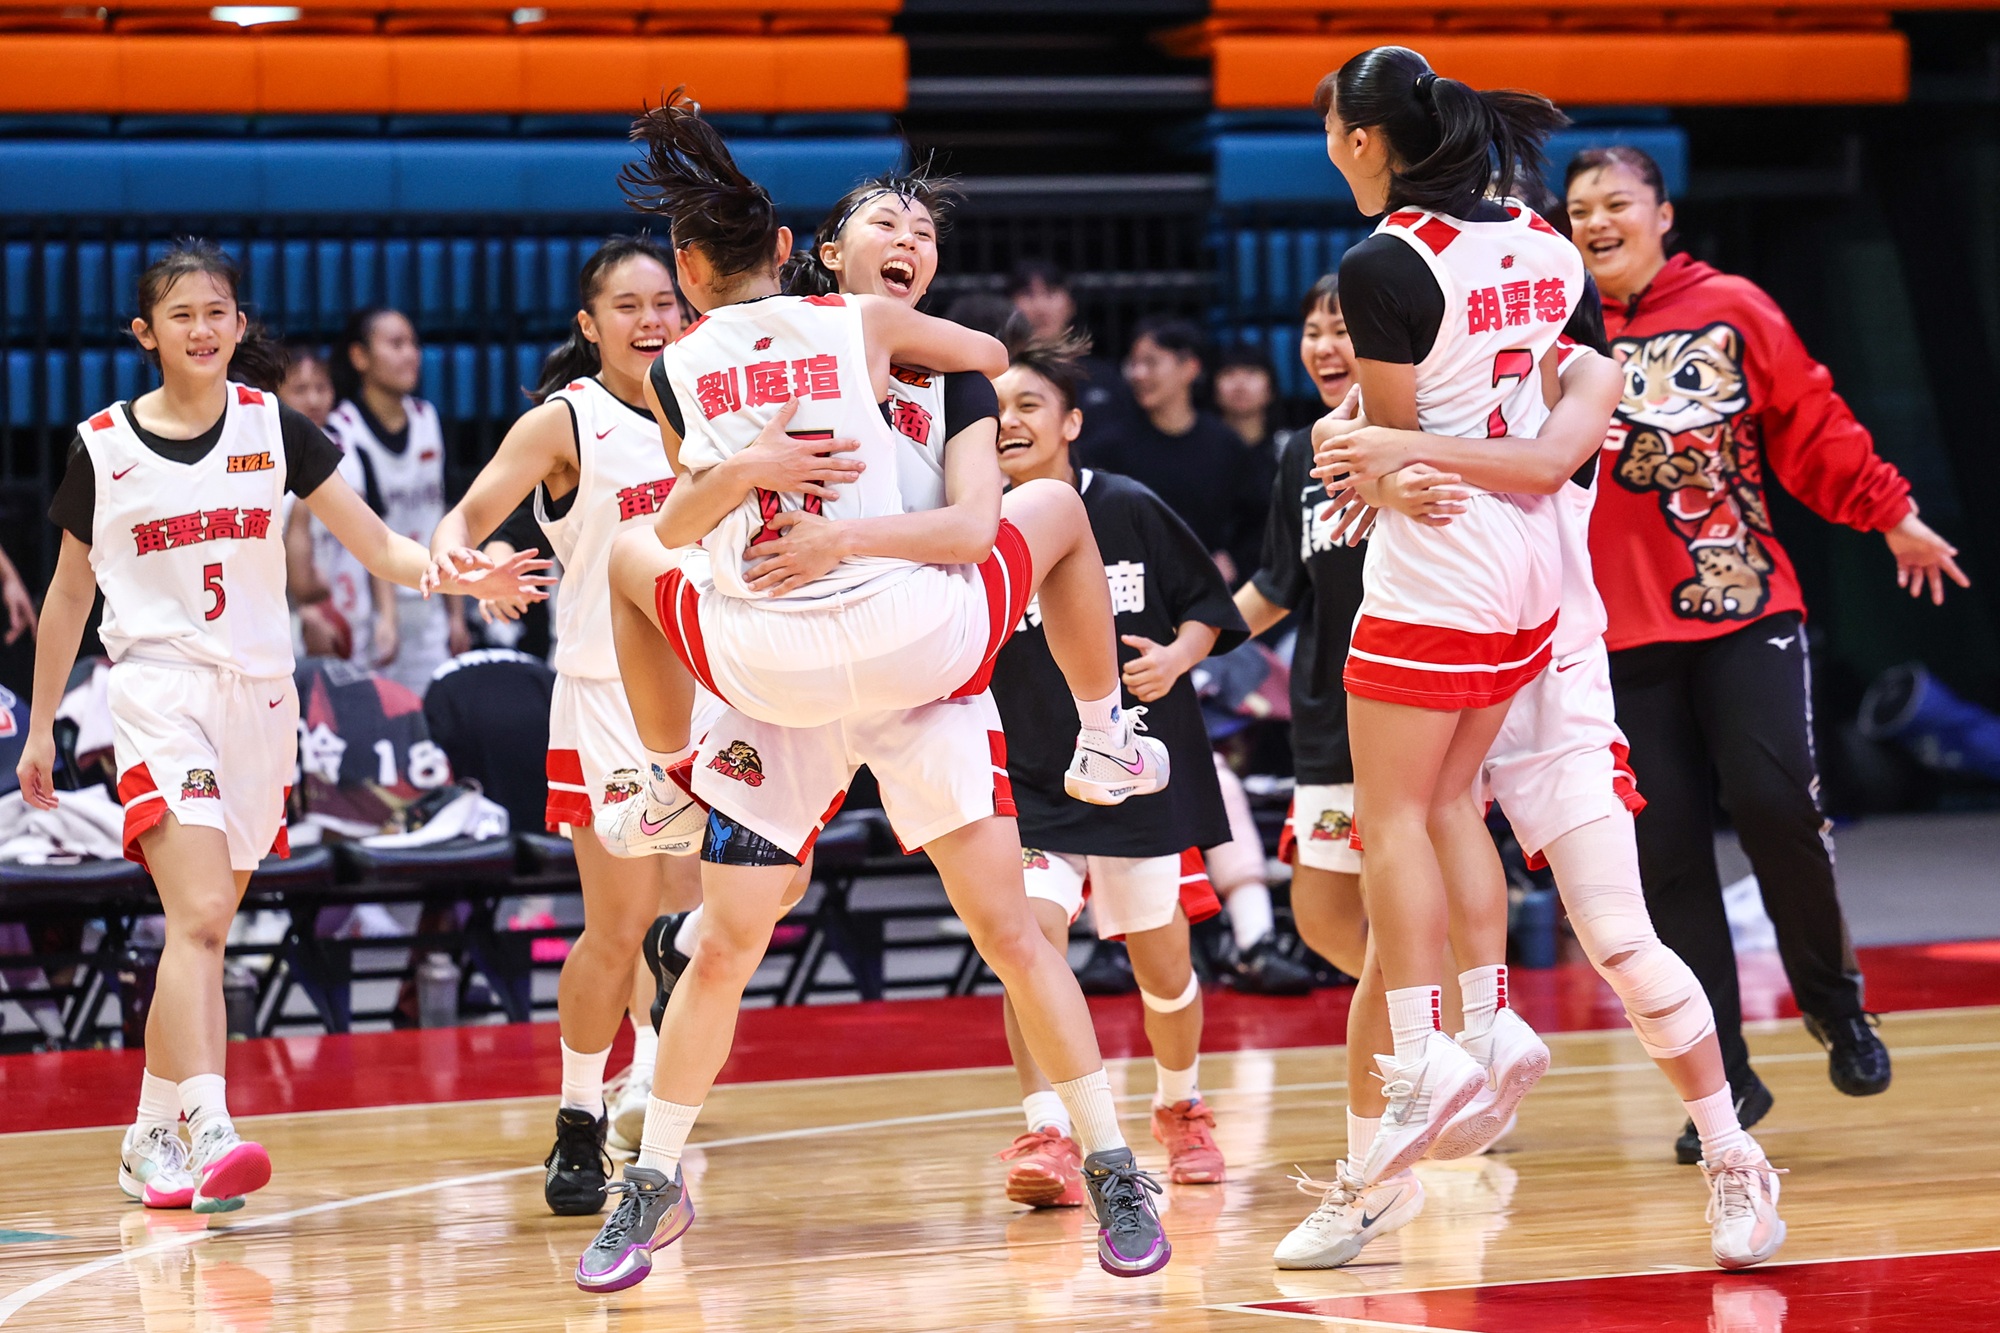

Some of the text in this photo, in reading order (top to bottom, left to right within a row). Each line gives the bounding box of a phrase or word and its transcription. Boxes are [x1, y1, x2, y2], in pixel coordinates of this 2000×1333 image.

[696, 353, 841, 421] 劉庭瑄
[887, 395, 933, 446] 商
[131, 507, 272, 557] 苗栗高商
[203, 562, 226, 622] 5
[373, 739, 451, 789] 18
